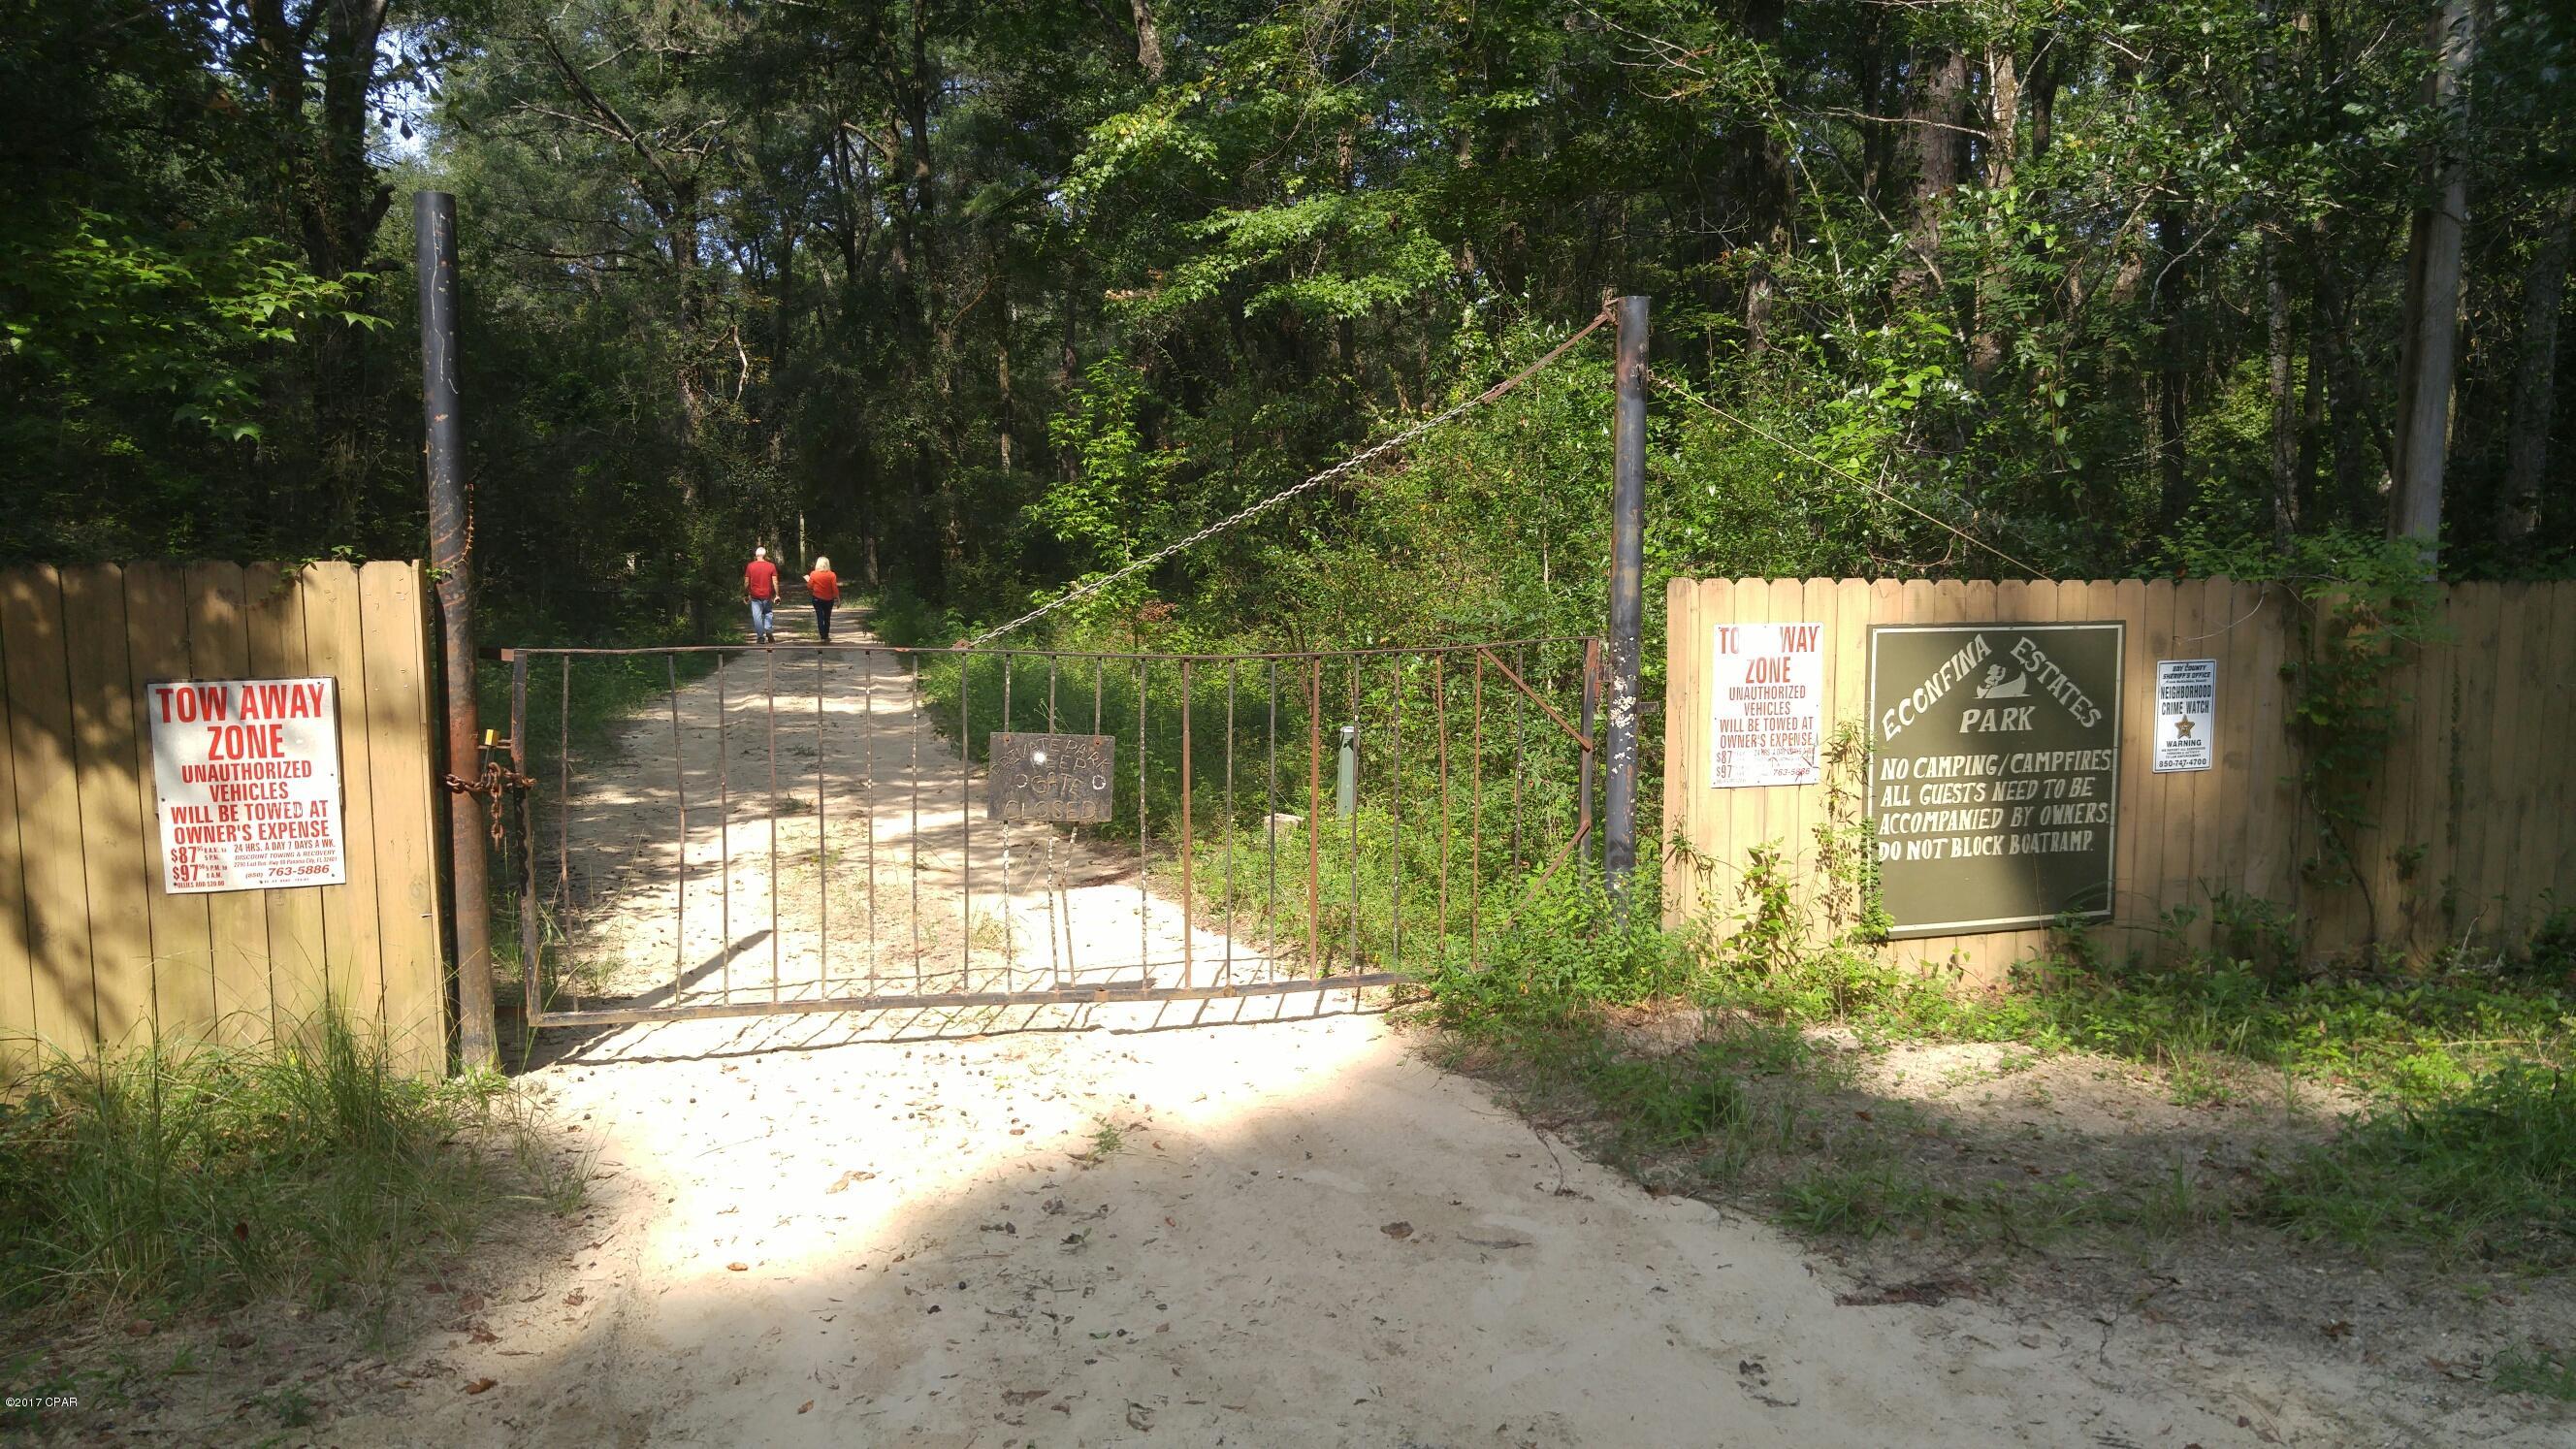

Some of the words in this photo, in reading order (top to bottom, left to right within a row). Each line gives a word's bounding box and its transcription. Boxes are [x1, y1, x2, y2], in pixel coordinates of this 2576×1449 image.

[1780, 626, 1819, 653] WAY
[1746, 657, 1791, 684] ZONE
[1729, 685, 1806, 700] UNAUTHORIZED
[1882, 633, 1992, 741] ECONFINA
[2010, 636, 2102, 729] ESTATES
[2160, 685, 2211, 699] NEIGHBORHOOD
[155, 686, 228, 723] TOW
[240, 684, 325, 721] AWAY
[1744, 701, 1791, 716] VEHICLES
[2161, 701, 2183, 715] CRIME
[2186, 699, 2209, 714] WATCH
[1720, 719, 1744, 732] WILL
[1748, 718, 1759, 732] BE
[1763, 717, 1798, 731] TOWED
[1802, 716, 1814, 730] AT
[1959, 705, 2036, 733] PARK
[207, 724, 285, 760] ZONE
[1720, 734, 1766, 748] OWNER'S
[1770, 732, 1813, 747] EXPENSE
[2166, 739, 2202, 748] WARNING
[990, 737, 1061, 775] PRIVATE
[1066, 739, 1111, 775] PARK
[1716, 750, 1732, 764] $87
[2159, 757, 2206, 767] 850-747-4700
[181, 759, 312, 784] UNAUTHORIZED
[1716, 764, 1732, 779] $97
[1880, 757, 1909, 781] NO
[209, 782, 289, 802] VEHICLES
[1030, 771, 1084, 797] GATE
[1880, 785, 1911, 807] ALL
[1919, 782, 1987, 806] GUESTS
[1991, 780, 2039, 802] NEED
[2044, 779, 2066, 799] TO
[2068, 777, 2096, 798] BE
[171, 805, 213, 824] WILL
[218, 804, 240, 822] BE
[244, 801, 304, 821] TOWED
[309, 800, 329, 818] AT
[1003, 799, 1097, 821] CLOSED
[1878, 808, 2004, 835] ACCOMPANIED
[2010, 806, 2035, 827] BY
[174, 824, 252, 845] OWNER'S
[258, 820, 330, 841] EXPENSE
[171, 846, 197, 864] $87
[234, 844, 242, 853] 24
[245, 842, 263, 852] HRS.
[265, 842, 270, 851] A
[272, 841, 285, 851] DAY
[287, 841, 292, 850] 7
[294, 840, 312, 850] DAYS
[315, 839, 319, 848] A
[321, 838, 336, 848] WK.
[1878, 841, 1901, 862] DO
[1906, 838, 1948, 860] NOT
[1950, 835, 2005, 858] BLOCK
[173, 863, 198, 882] $97
[268, 864, 330, 877] 763-5886
